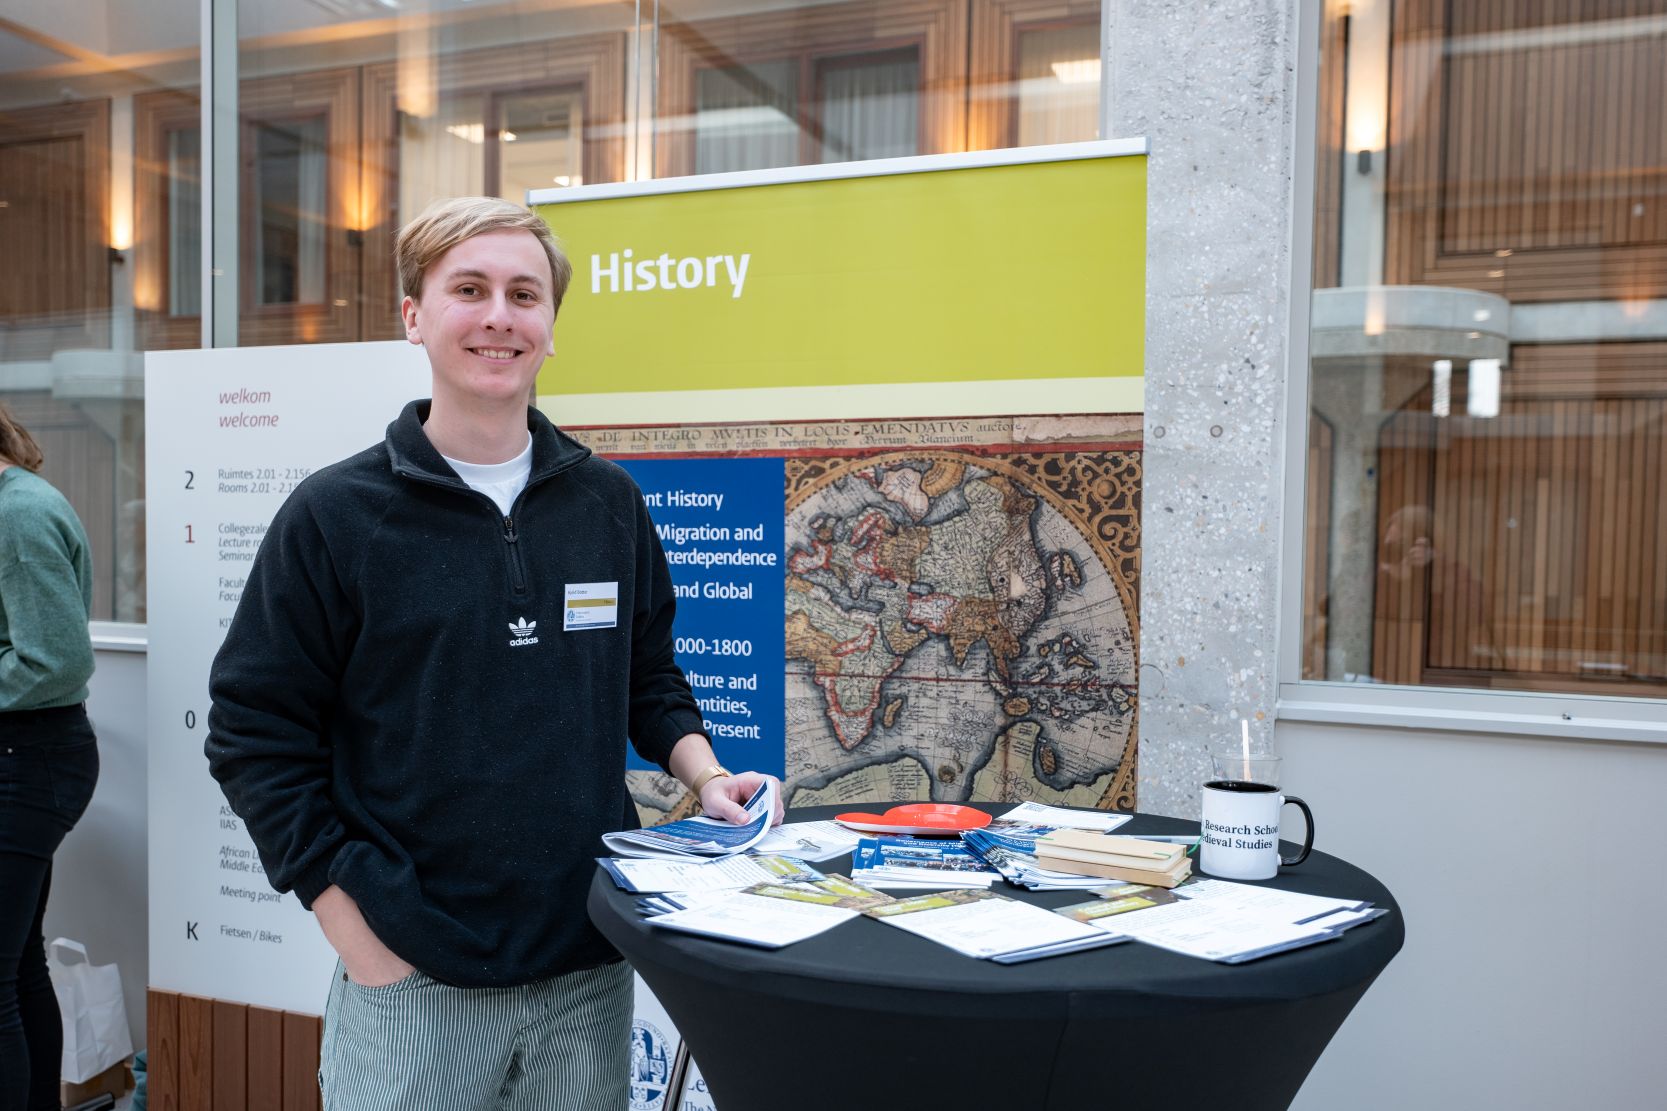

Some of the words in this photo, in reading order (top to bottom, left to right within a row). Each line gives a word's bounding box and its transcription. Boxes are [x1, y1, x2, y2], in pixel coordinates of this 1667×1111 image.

[591, 248, 751, 298] History
[219, 388, 271, 404] welkom
[219, 412, 279, 428] welcome
[631, 430, 702, 442] INTEGRO
[774, 426, 793, 437] IN
[804, 425, 850, 437] LOCIS
[861, 422, 969, 435] EMENDATVS
[184, 470, 194, 490] 2
[218, 468, 254, 480] Ruimtes
[256, 468, 275, 480] 2.01
[218, 482, 248, 493] Rooms
[250, 482, 270, 493] 2.01
[643, 491, 663, 507] nt
[667, 489, 724, 511] History
[185, 524, 195, 543] 1
[655, 522, 729, 545] Migration
[734, 523, 763, 541] and
[218, 537, 251, 548] Lecture
[218, 550, 254, 561] Seminar
[673, 582, 699, 598] and
[703, 582, 753, 599] Global
[510, 636, 538, 647] adidas
[673, 637, 752, 656] 000-1800
[728, 673, 757, 691] and
[185, 710, 196, 729] 0
[703, 720, 760, 739] Present
[220, 819, 237, 831] IIAS
[1205, 819, 1251, 835] Research
[219, 845, 250, 859] African
[1235, 839, 1273, 849] Studies
[220, 859, 250, 872] Middle
[220, 885, 256, 903] Meeting
[258, 891, 281, 903] point
[187, 920, 199, 941] K
[220, 925, 251, 939] Fietsen
[259, 931, 282, 943] Bikes
